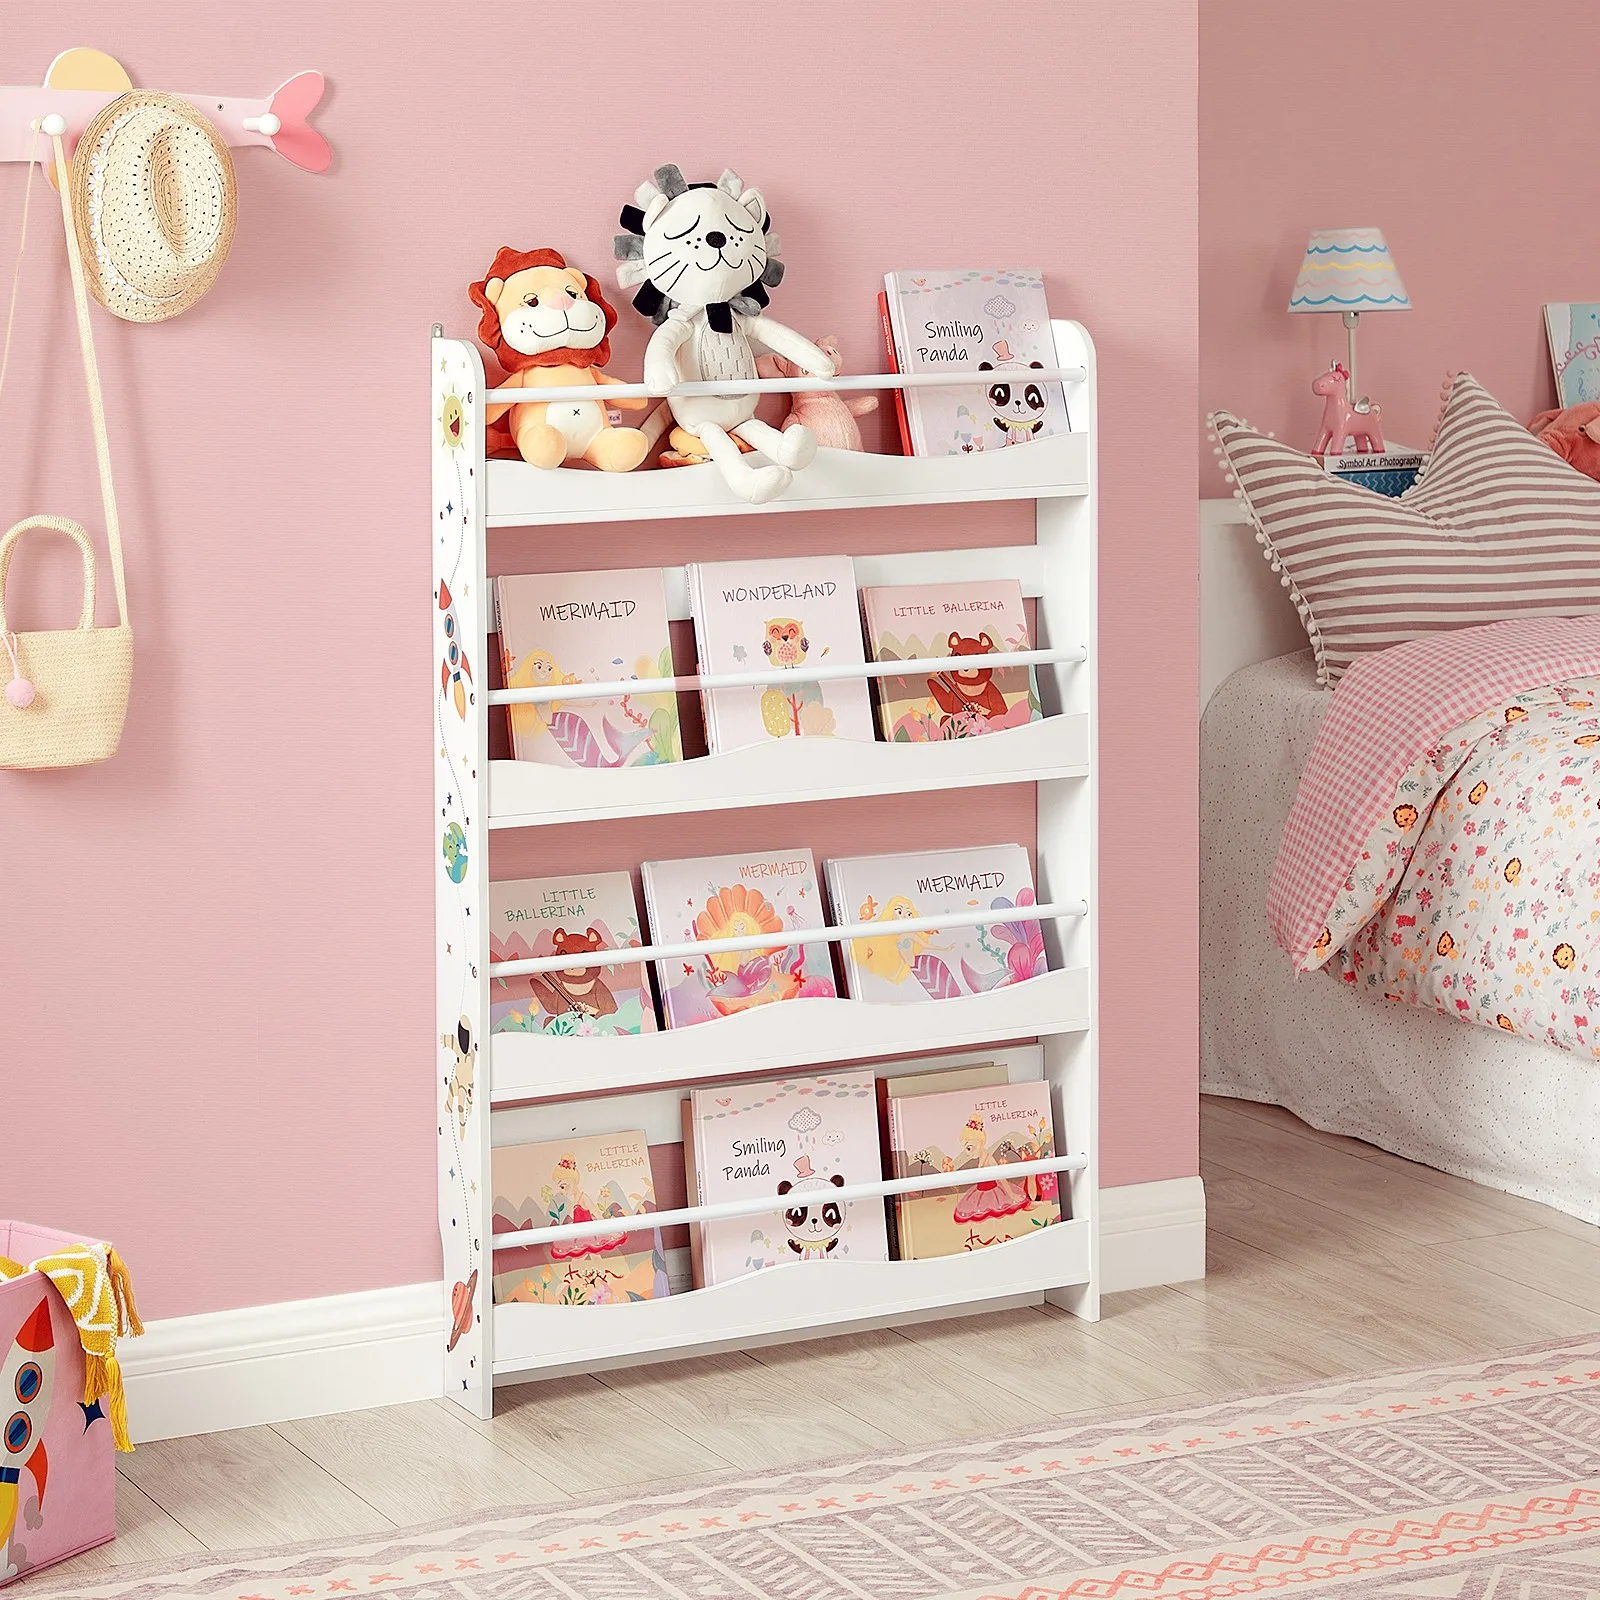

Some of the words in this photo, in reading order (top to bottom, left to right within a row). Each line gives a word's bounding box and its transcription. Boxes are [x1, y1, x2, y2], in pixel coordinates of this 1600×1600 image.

[924, 320, 984, 344] Smiling
[916, 343, 969, 363] Panda
[1339, 459, 1365, 469] Symbol
[1365, 458, 1376, 467] Art
[1379, 456, 1423, 469] Photography
[722, 580, 838, 603] WONDERLAND
[539, 599, 637, 622] MERMAID
[894, 605, 936, 617] LITTLE
[942, 601, 1004, 613] BALLERINA
[738, 860, 809, 880] MERMAID
[916, 871, 1006, 894] MERMAID
[542, 887, 596, 904] LITTLE
[504, 904, 586, 923] BALLERINA
[974, 1099, 1008, 1112] LITTLE
[989, 1108, 1039, 1123] BALLERINA
[599, 1143, 640, 1158] LITTLE
[731, 1136, 787, 1158] Smiling
[585, 1156, 646, 1173] BALLERINA
[722, 1159, 771, 1181] Panda
